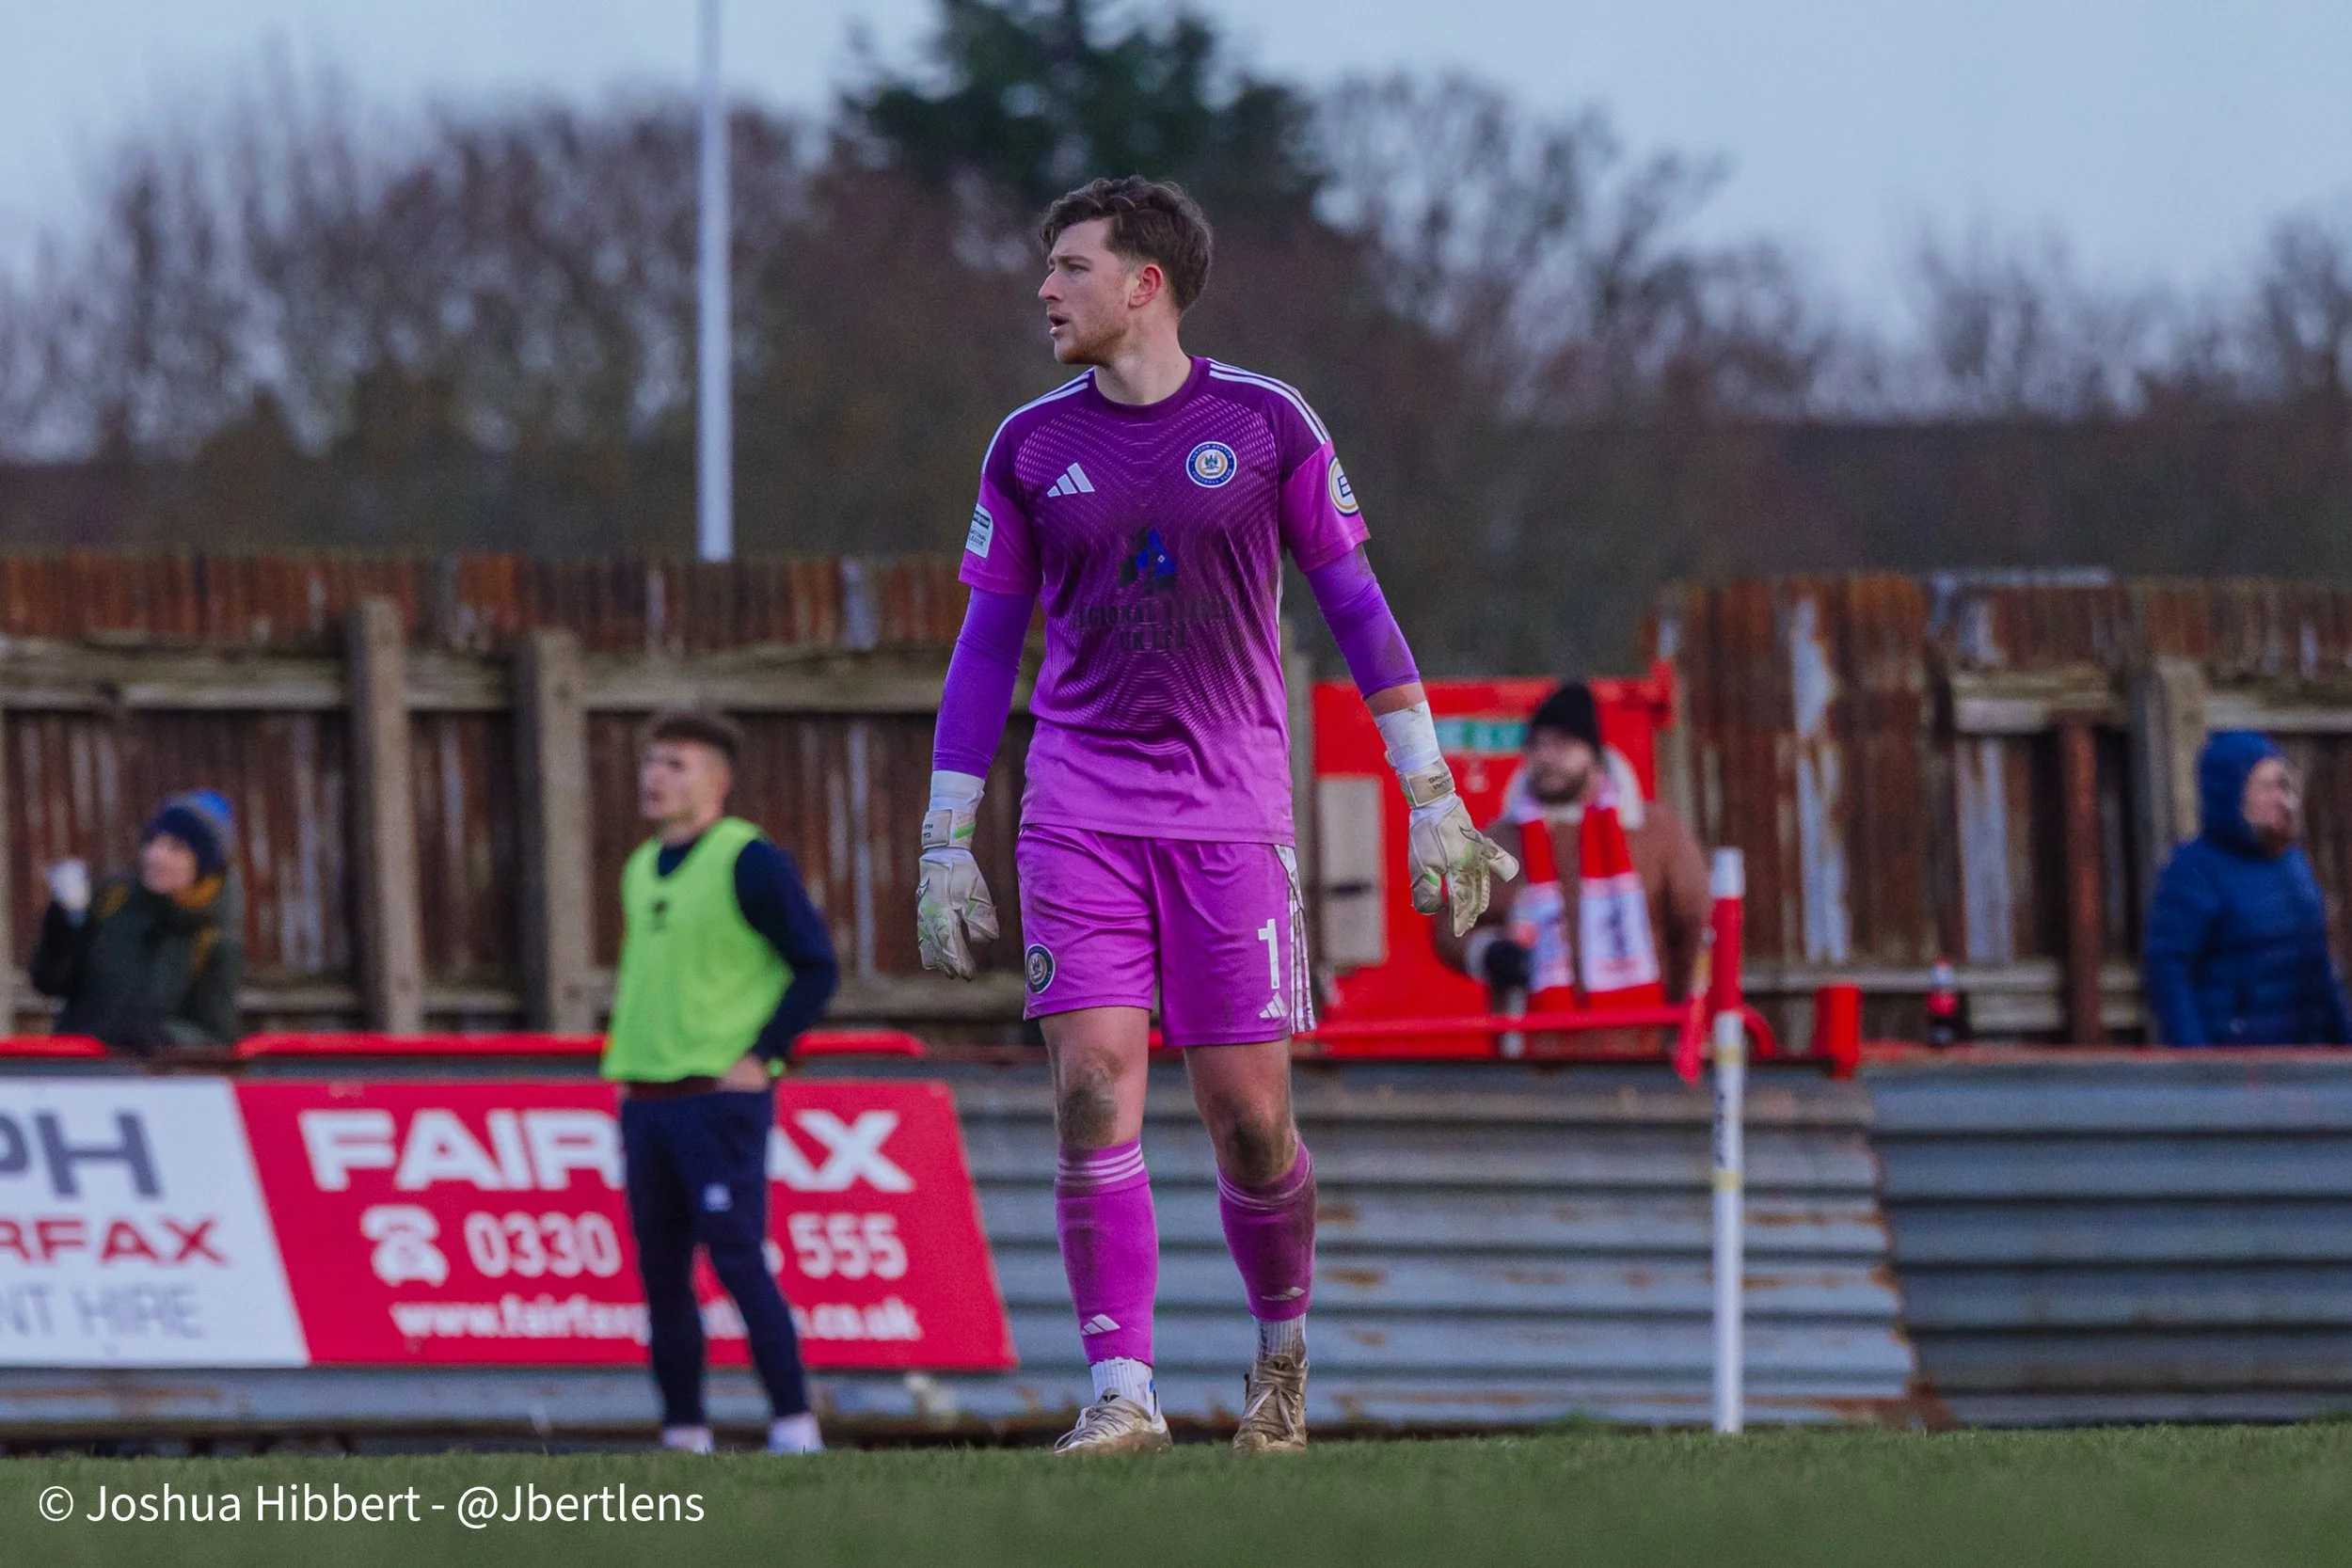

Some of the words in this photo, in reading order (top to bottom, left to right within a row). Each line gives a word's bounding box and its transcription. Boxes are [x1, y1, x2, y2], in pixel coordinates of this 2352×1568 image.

[1257, 918, 1279, 990] 1
[298, 1109, 914, 1193] FAIRX
[464, 1212, 622, 1277] 0330
[787, 1213, 908, 1279] 555
